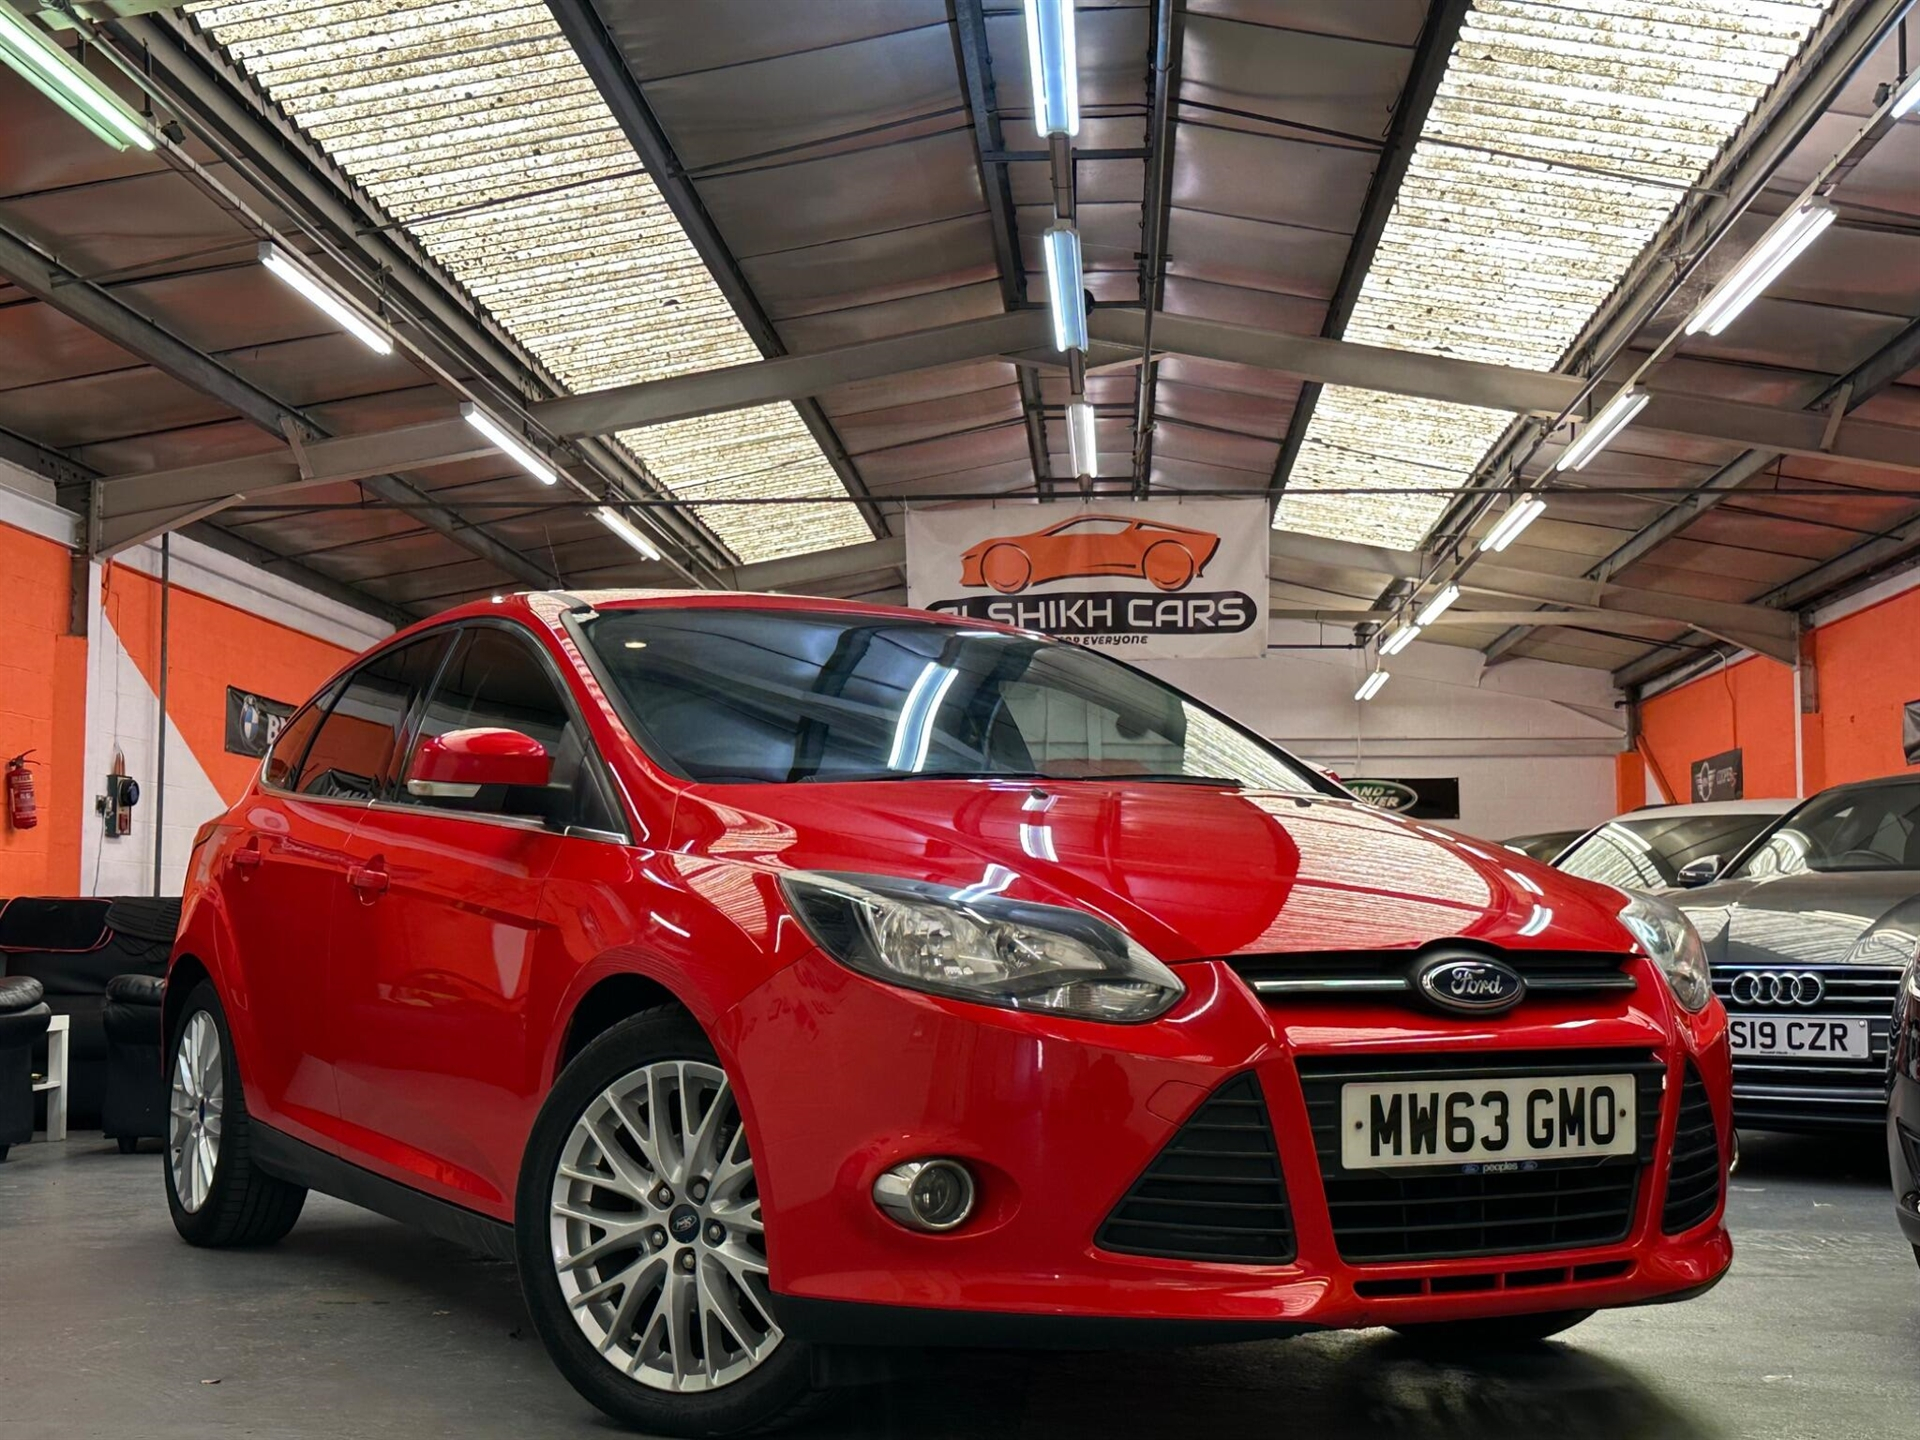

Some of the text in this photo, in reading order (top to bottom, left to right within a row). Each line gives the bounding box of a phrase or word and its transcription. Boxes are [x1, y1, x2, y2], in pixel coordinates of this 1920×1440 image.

[987, 599, 1112, 629] SHIKH
[1128, 597, 1246, 628] CARS
[1083, 635, 1148, 645] EVERYONE
[1451, 967, 1503, 994] Ford
[1730, 1021, 1848, 1051] S19 CZR
[1370, 1086, 1615, 1156] MW63 GMO
[1483, 1162, 1518, 1174] peoples
